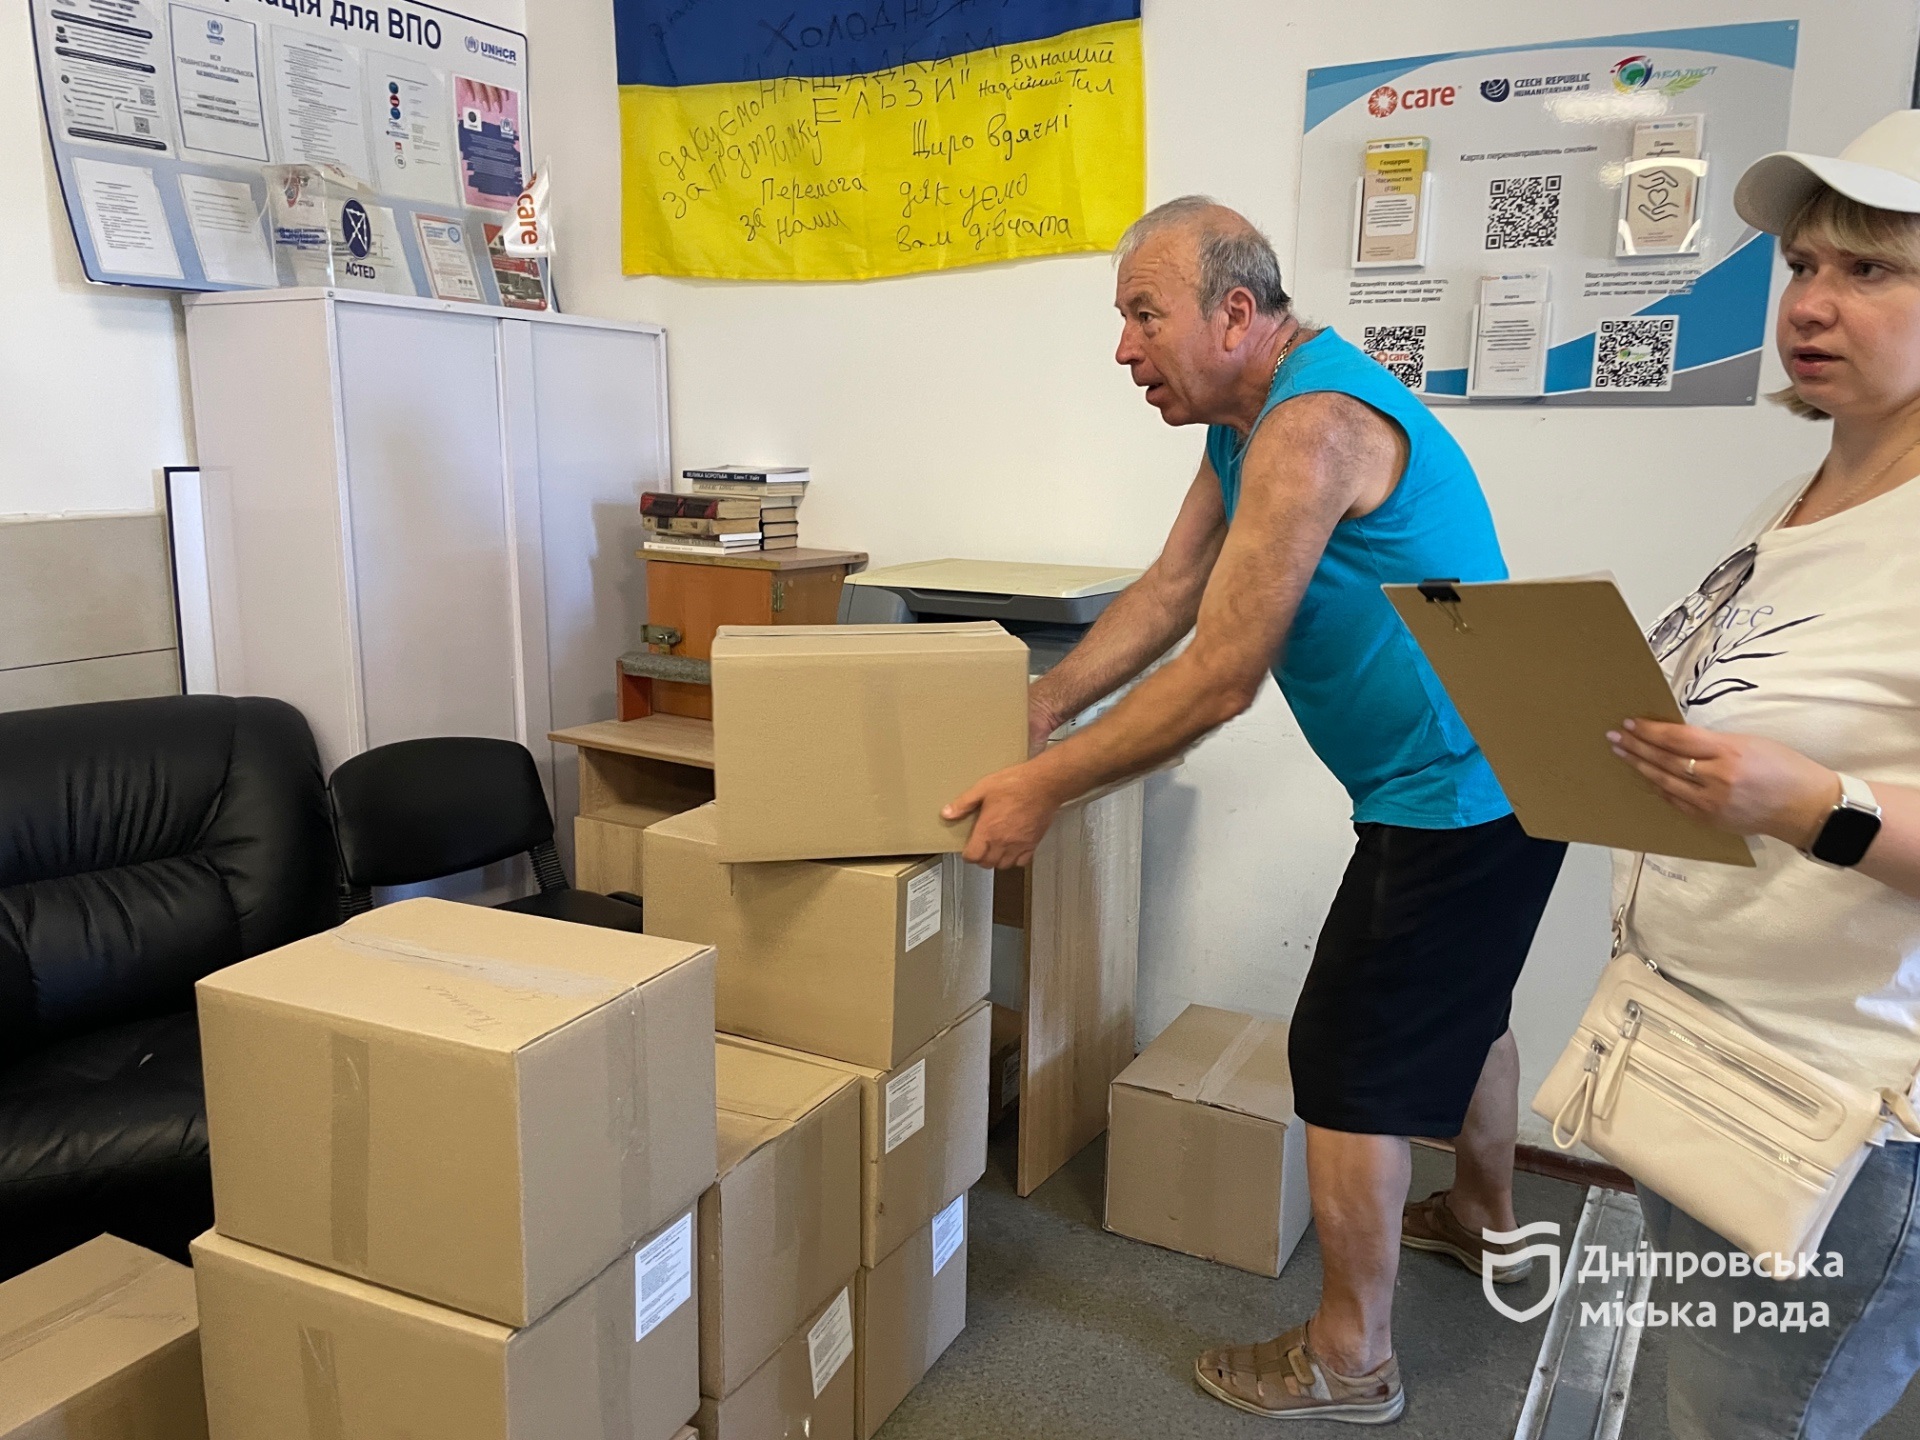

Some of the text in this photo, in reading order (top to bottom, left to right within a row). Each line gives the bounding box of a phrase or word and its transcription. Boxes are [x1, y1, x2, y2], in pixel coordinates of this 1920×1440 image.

[330, 0, 379, 33] для
[388, 7, 442, 50] ВПО
[481, 42, 516, 61] UNHCR
[1513, 83, 1591, 98] HUMANITARIAN AID
[1514, 72, 1591, 88] CZECH REPUBLIC
[1401, 86, 1456, 110] care
[912, 118, 974, 166] Щиро
[517, 193, 539, 246] care
[968, 208, 1074, 251] дівчата
[345, 262, 376, 280] ACTED
[1388, 352, 1410, 361] care
